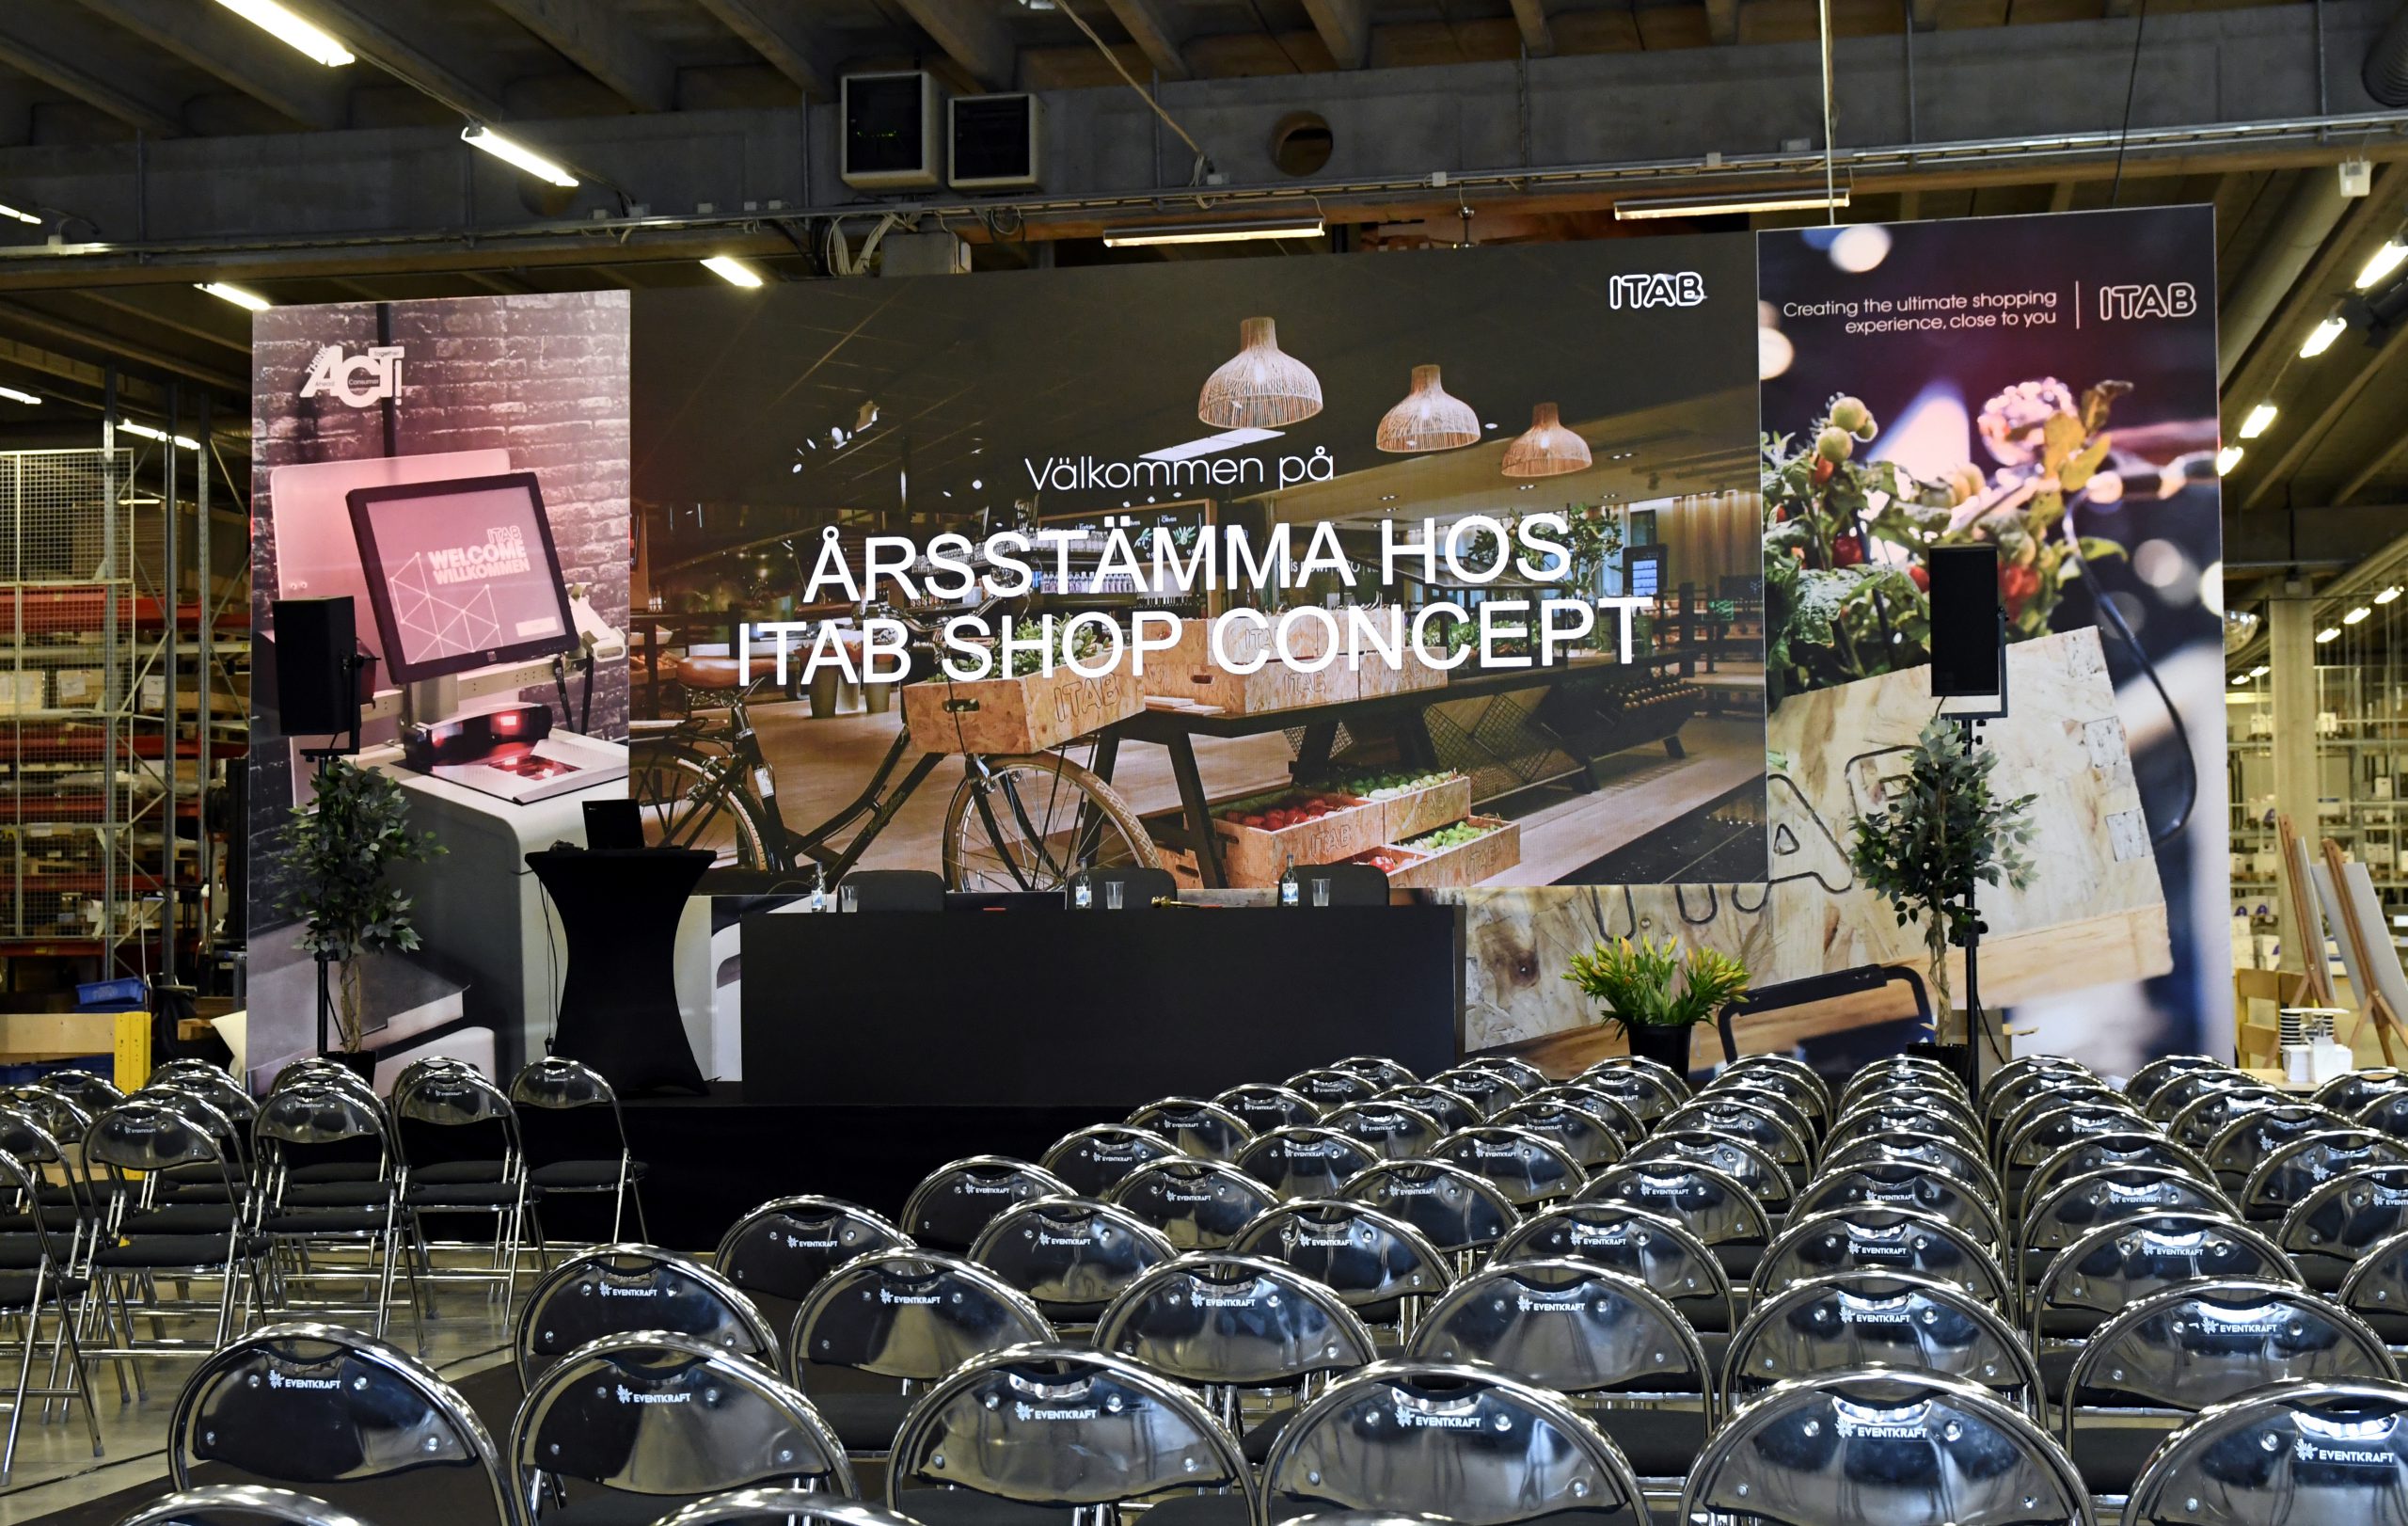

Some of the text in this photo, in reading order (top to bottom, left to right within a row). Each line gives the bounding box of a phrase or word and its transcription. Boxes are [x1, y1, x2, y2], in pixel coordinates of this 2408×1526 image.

[1609, 272, 1703, 310] ITAB
[1783, 291, 2057, 318] Creating the ultimate shopping
[2099, 282, 2196, 321] ITAB
[1845, 311, 2056, 336] experience, close to you
[1024, 446, 1334, 490] Välkommen på
[487, 526, 522, 544] ITAB
[428, 540, 527, 570] WELCOME
[802, 513, 1572, 603] ÅRSSTÄMMA HOS
[433, 558, 531, 585] WILLKOMMEN
[738, 596, 1653, 687] ITAB SHOP CONCEPT
[1283, 671, 1325, 697] ITAB
[1054, 672, 1119, 723] ITAB
[1309, 824, 1352, 856] ITAB
[799, 1239, 838, 1248] EVENTKRAFT
[1051, 1237, 1091, 1246] EVENTKRAFT
[1311, 1238, 1353, 1247] EVENTKRAFT
[1583, 1237, 1626, 1246] EVENTKRAFT
[1861, 1247, 1907, 1255] EVENTKRAFT
[2156, 1248, 2203, 1256] EVENTKRAFT
[612, 1287, 657, 1297] EVENTKRAFT
[894, 1296, 941, 1305] EVENTKRAFT
[1205, 1297, 1256, 1308] EVENTKRAFT
[1533, 1302, 1586, 1311] EVENTKRAFT
[1856, 1313, 1910, 1324] EVENTKRAFT
[2220, 1324, 2277, 1333] EVENTKRAFT
[285, 1378, 341, 1390] EVENTKRAFT
[633, 1392, 691, 1404] EVENTKRAFT
[1035, 1408, 1097, 1421] EVENTKRAFT
[1416, 1416, 1481, 1428] EVENTKRAFT
[1857, 1426, 1927, 1439] EVENTKRAFT
[2319, 1450, 2395, 1463] EVENTKRAFT
